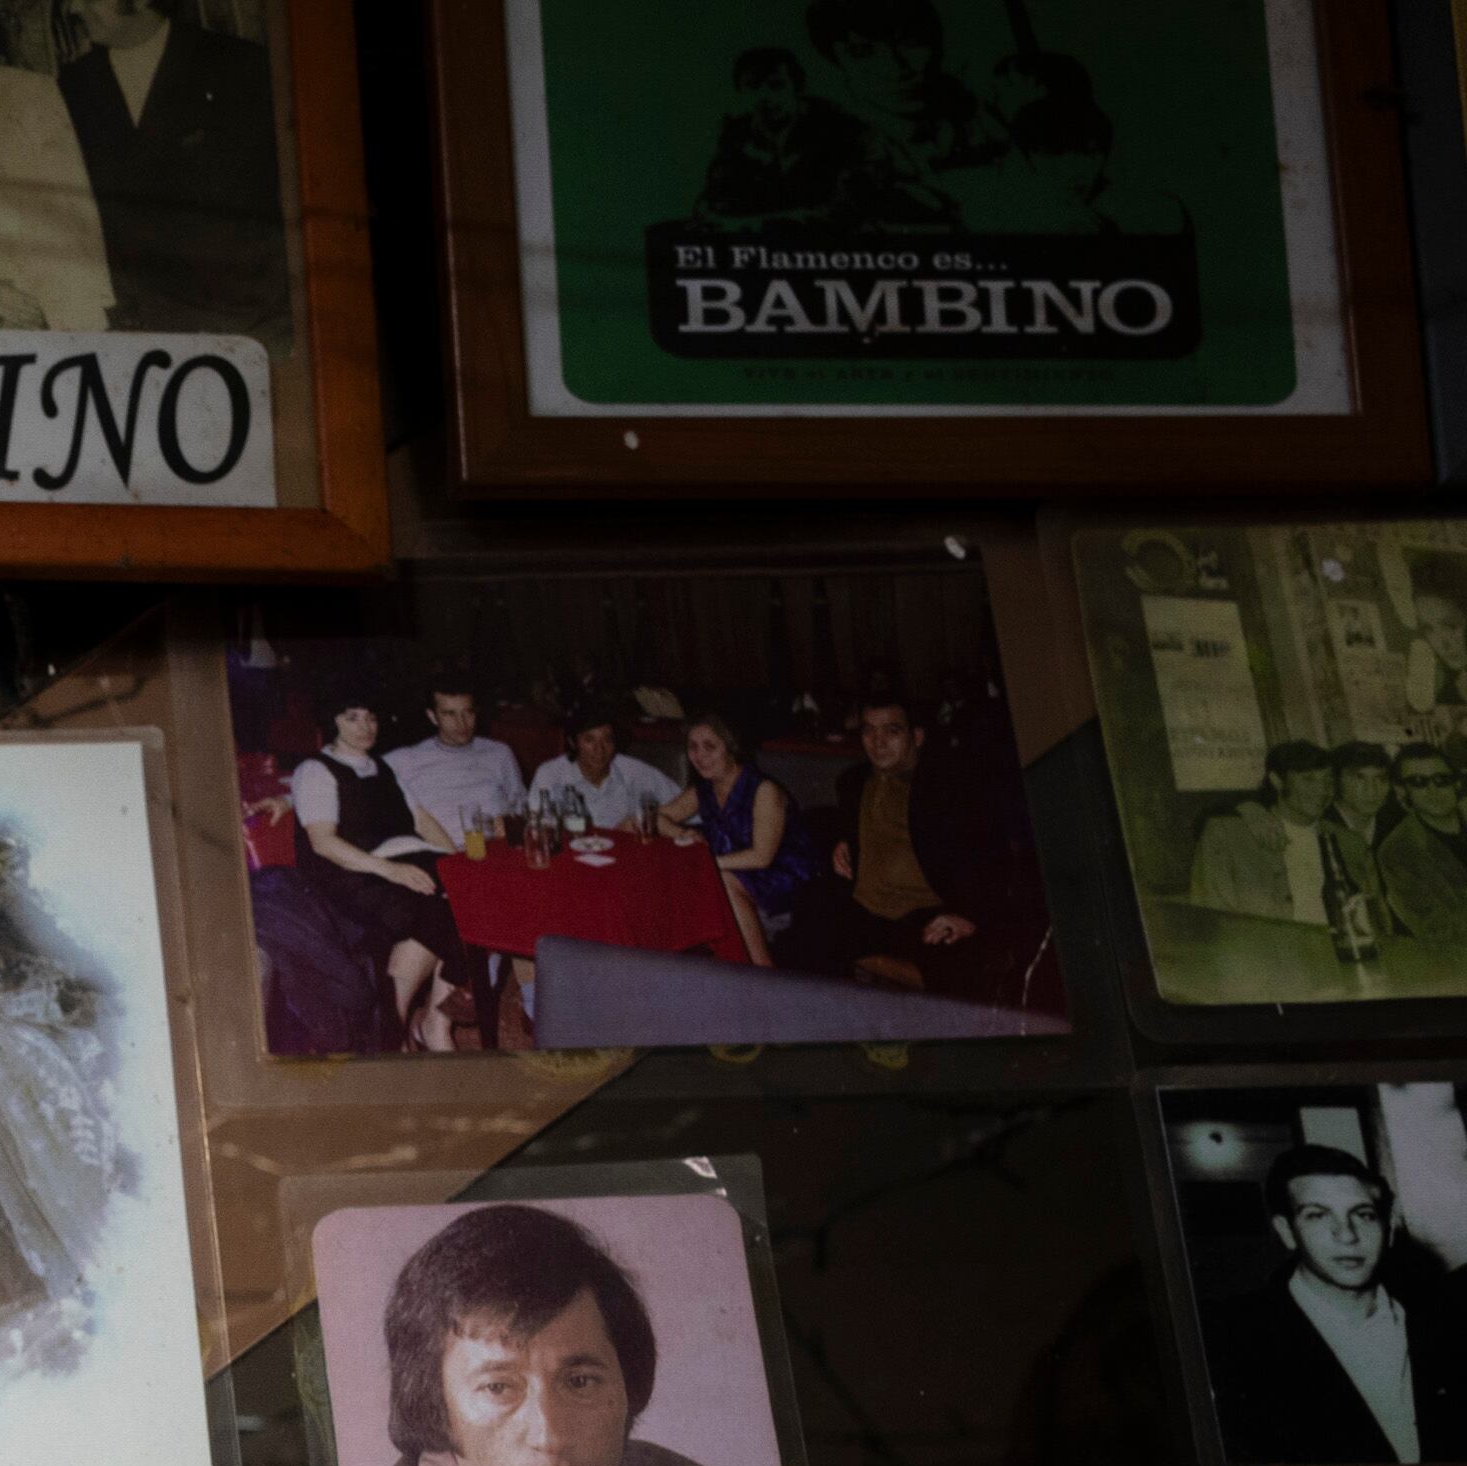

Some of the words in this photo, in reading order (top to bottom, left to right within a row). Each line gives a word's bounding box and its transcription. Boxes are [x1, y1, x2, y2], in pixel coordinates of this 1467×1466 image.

[675, 244, 717, 271] El
[733, 244, 920, 272] Flamenco
[934, 252, 1009, 272] es...
[676, 278, 1173, 339] BAMBINO
